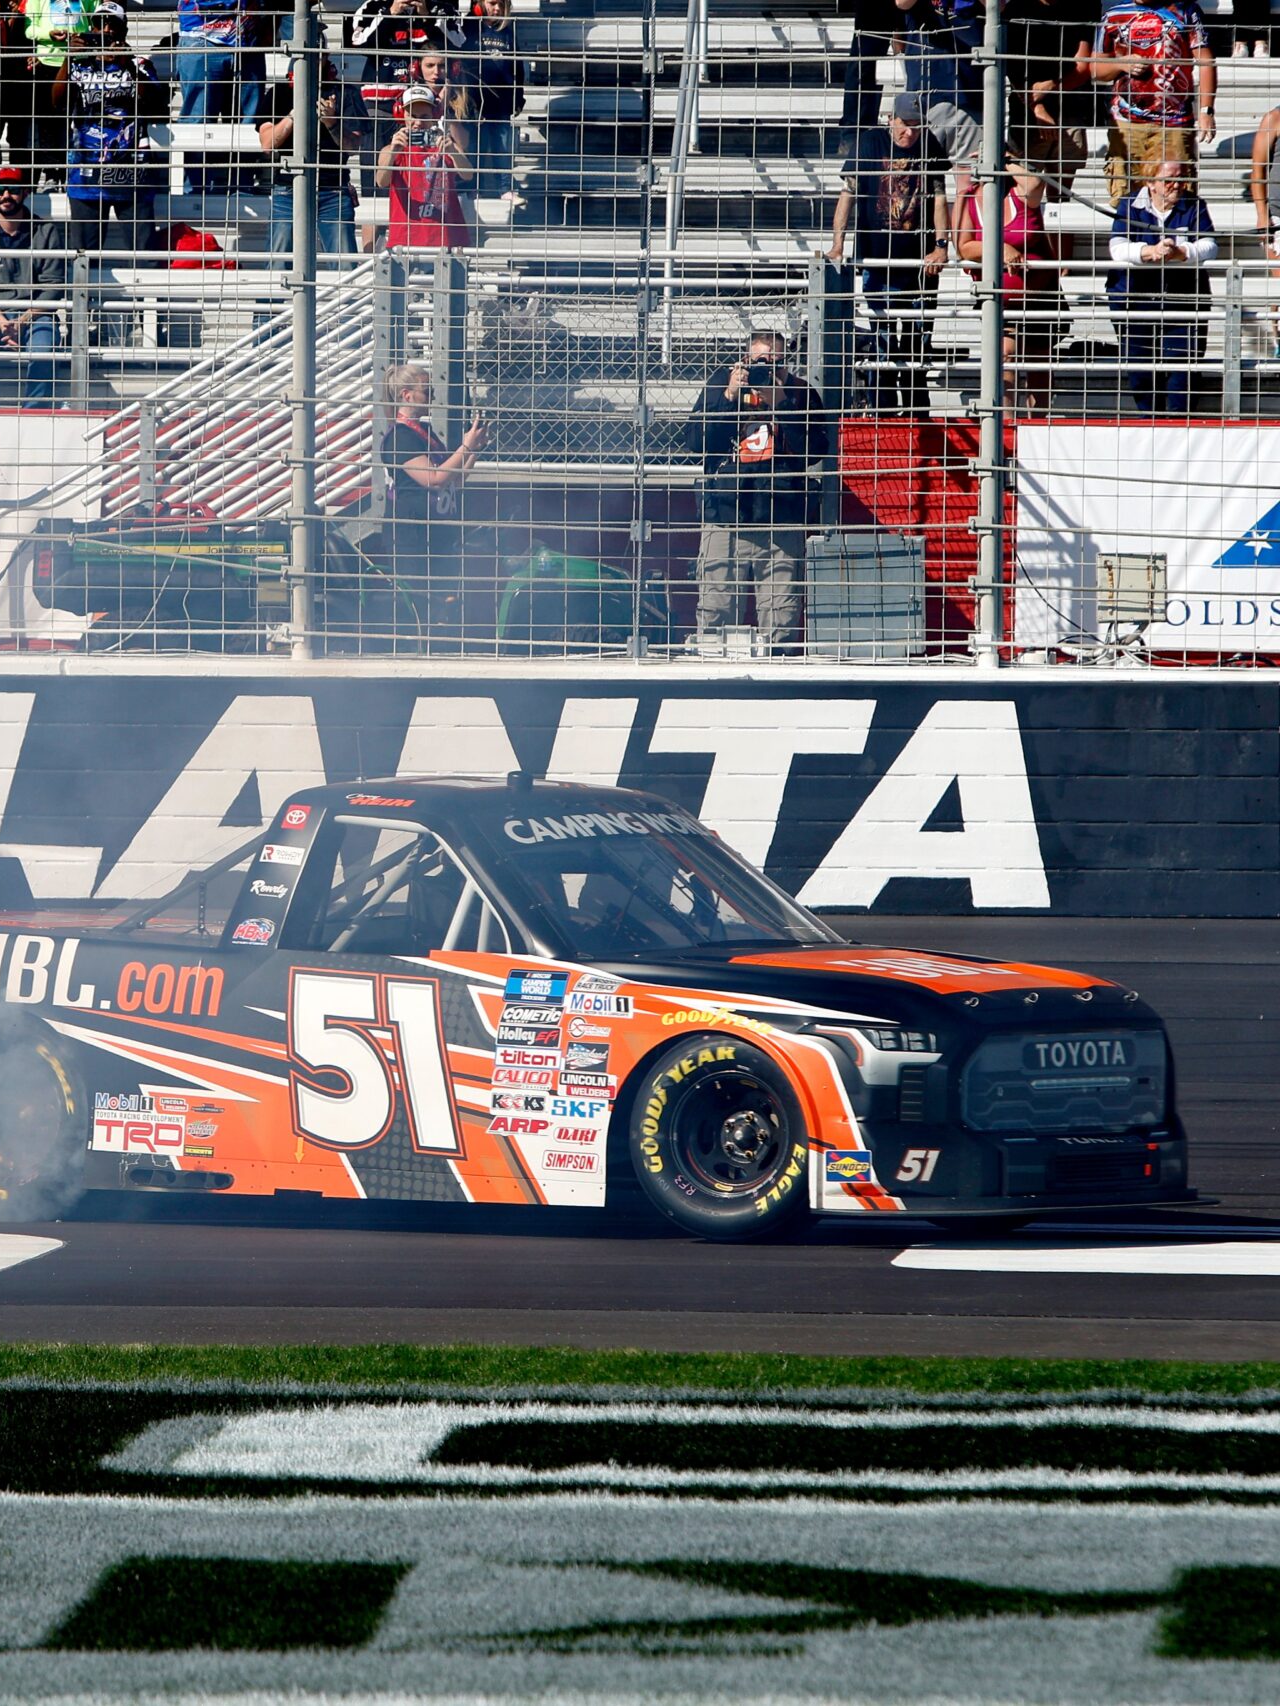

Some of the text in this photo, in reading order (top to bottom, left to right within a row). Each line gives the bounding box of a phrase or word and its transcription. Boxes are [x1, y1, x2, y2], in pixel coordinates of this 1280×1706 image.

[504, 812, 650, 844] CAMPING
[250, 879, 289, 899] Rowdy
[232, 923, 271, 942] KBM
[521, 986, 552, 996] WORLD
[570, 993, 612, 1012] Mobil
[502, 1007, 562, 1023] COMETIC
[498, 1026, 537, 1046] Holley
[287, 966, 468, 1160] 51
[500, 1049, 557, 1066] tilton
[1035, 1040, 1127, 1068] TOYOTA
[493, 1069, 552, 1085] CALICO
[560, 1072, 608, 1087] LINCOLN
[95, 1092, 139, 1111] Mobil
[570, 1086, 611, 1098] WELDERS
[96, 1110, 184, 1124] TOYOTA RACING DEVELOPMENT
[551, 1099, 606, 1119] SKF
[640, 1046, 736, 1174] GOODYEAR
[489, 1117, 550, 1134] ARP
[95, 1119, 183, 1153] TRD
[545, 1153, 595, 1170] SIMPSON
[827, 1161, 870, 1174] SUNOCO
[895, 1148, 941, 1183] 51
[755, 1144, 808, 1217] EAGLE
